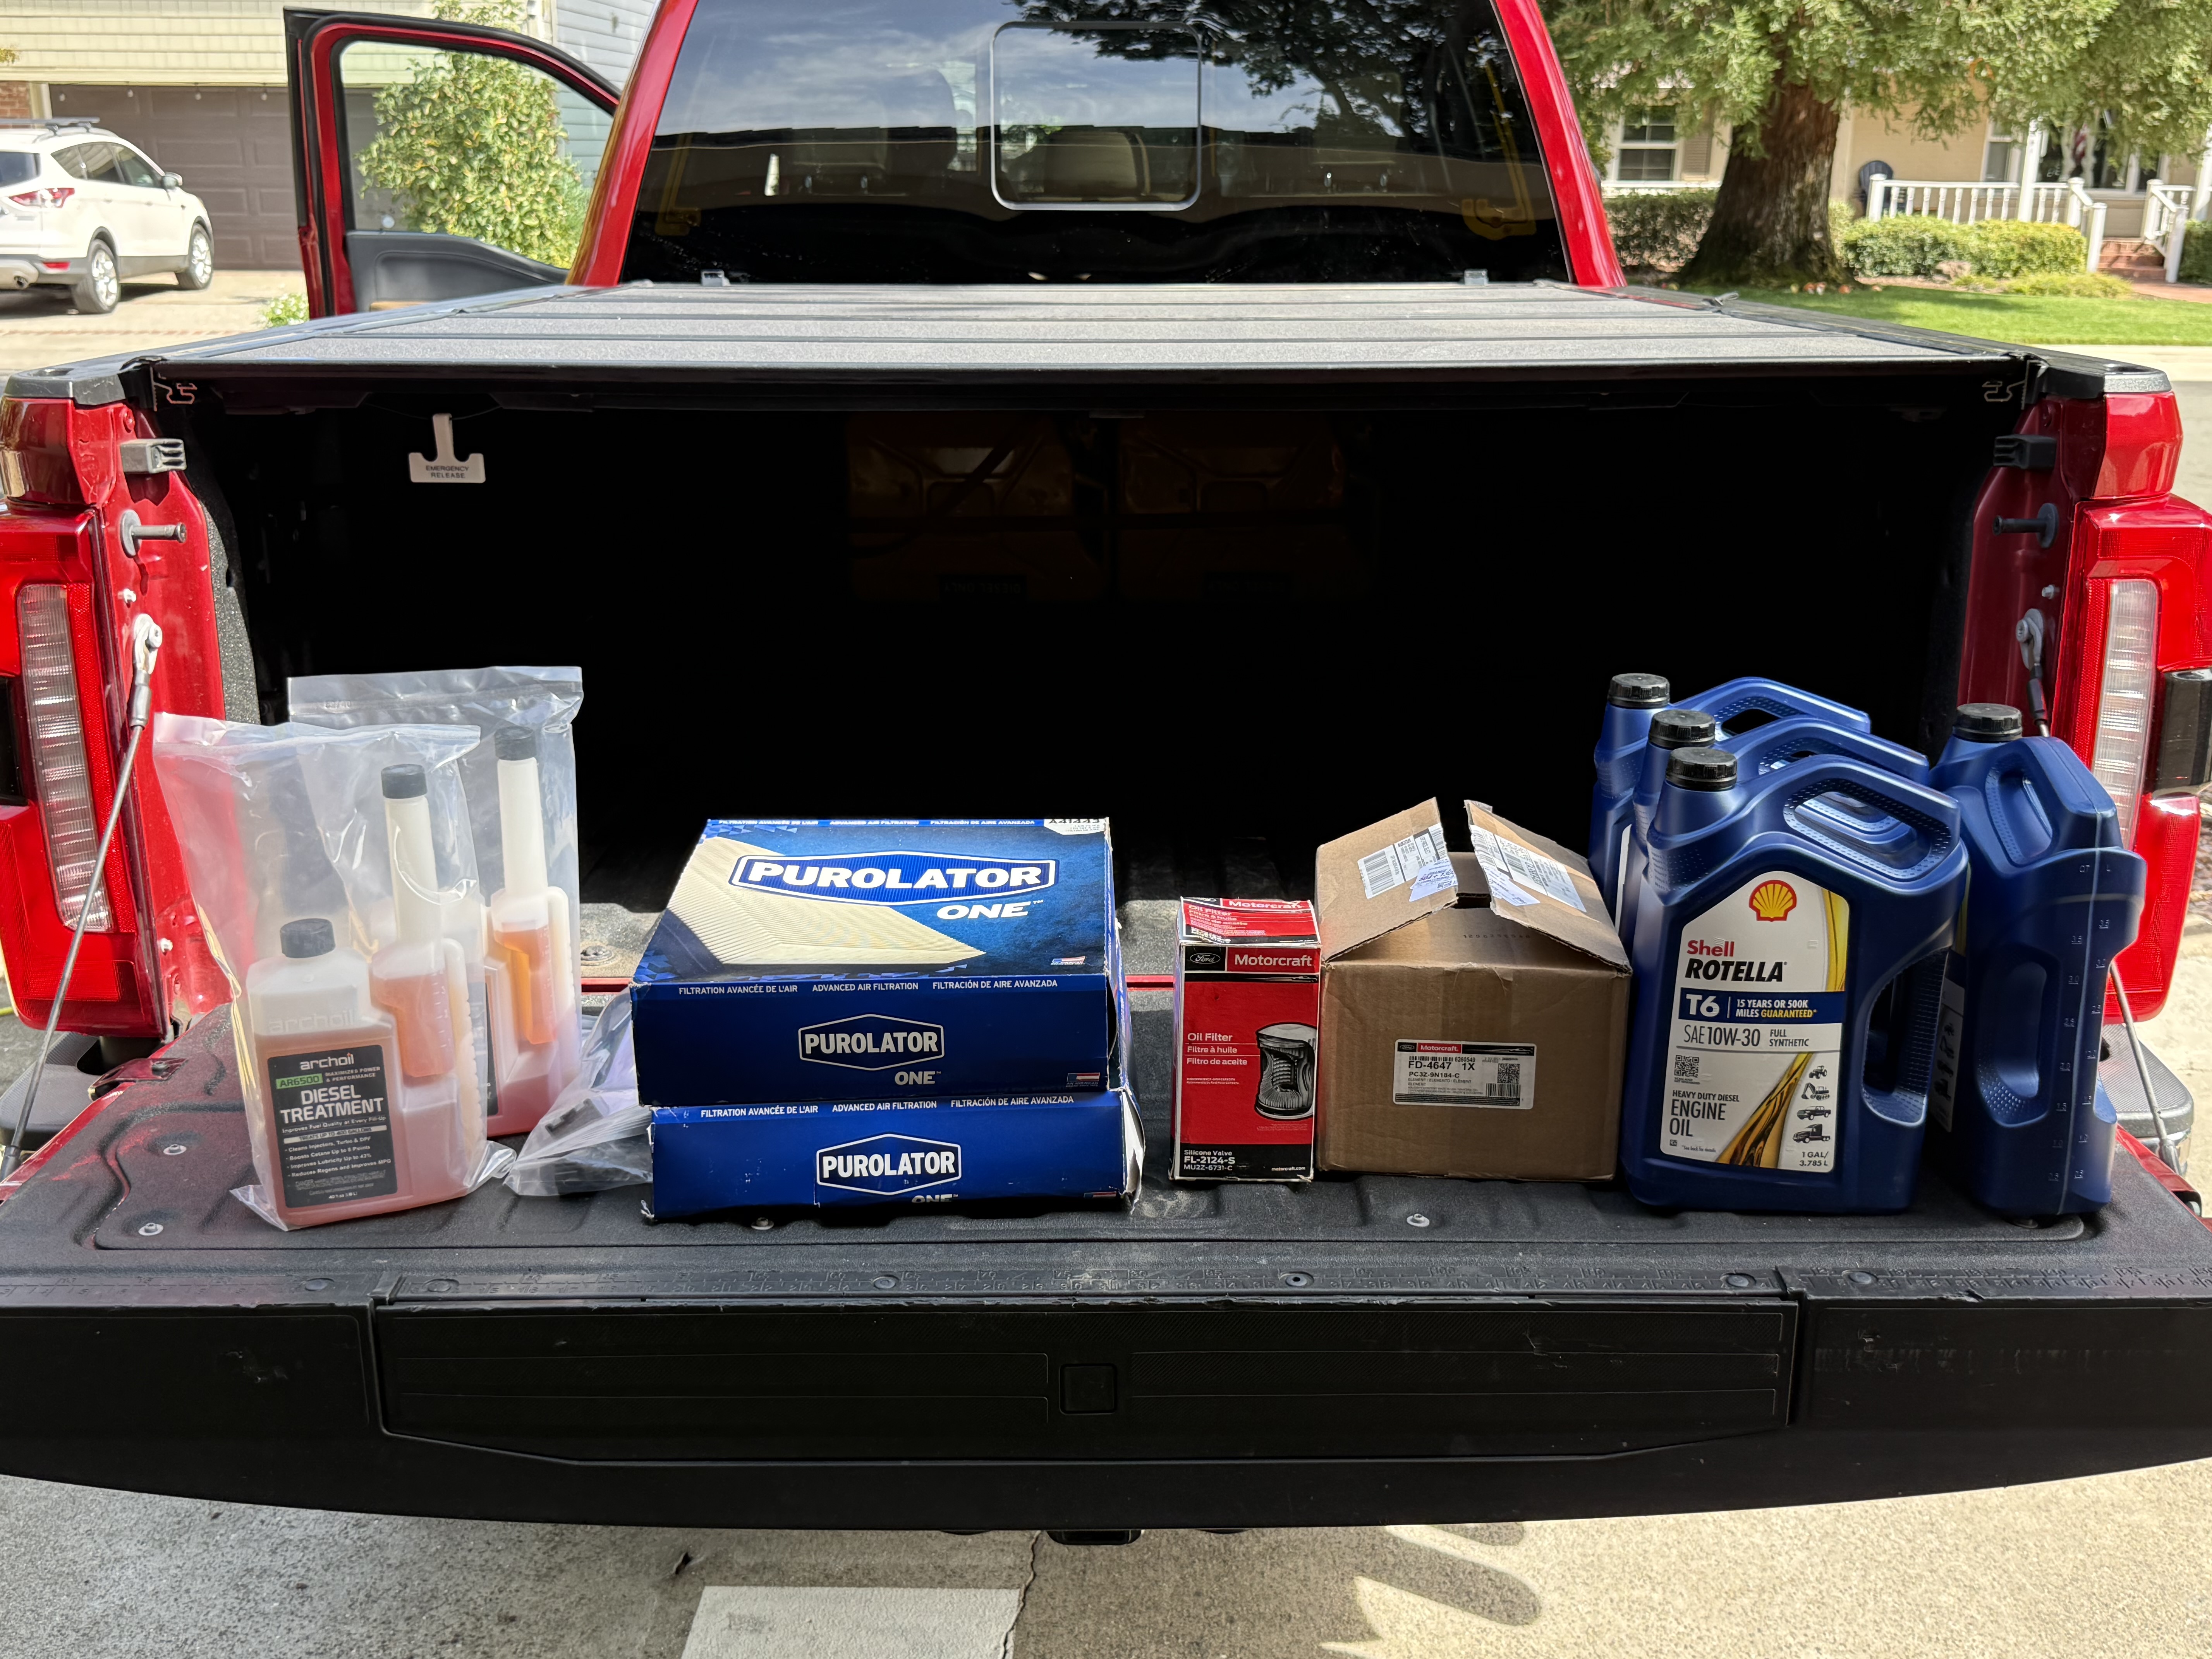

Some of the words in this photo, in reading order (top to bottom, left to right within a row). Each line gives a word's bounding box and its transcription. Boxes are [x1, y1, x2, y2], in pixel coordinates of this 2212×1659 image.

[748, 861, 1042, 888] PUROLATOR
[937, 902, 1031, 920] ONE
[1687, 939, 1734, 957] Shell
[1195, 954, 1215, 962] Ford
[1235, 954, 1312, 966] Motorcraft
[1685, 958, 1783, 982] ROTELLA
[679, 986, 725, 994] FILTRATION
[727, 984, 764, 993] AVANCÉE
[873, 982, 918, 991] FILTRATION
[933, 980, 979, 989] FILTRACIÓN
[993, 980, 1011, 988] AIRE
[1014, 979, 1058, 988] AVANZADA
[1686, 994, 1720, 1017] T6
[1737, 1000, 1745, 1008] 15
[1747, 1000, 1772, 1008] YEARS
[1788, 1000, 1808, 1008] 500K
[1736, 1009, 1759, 1017] MILES
[805, 1032, 938, 1054] PUROLATOR
[1188, 1033, 1202, 1041] Oil
[1205, 1033, 1233, 1041] Filter
[1684, 1025, 1705, 1044] SAE
[1707, 1026, 1760, 1046] 10W-30
[1769, 1038, 1809, 1046] SYNTHETIC
[300, 1053, 354, 1070] archoil
[1408, 1061, 1451, 1070] FD-4647
[280, 1075, 319, 1087] AR6500
[332, 1073, 376, 1082] PERFORMANCE
[895, 1071, 935, 1085] ONE
[301, 1085, 361, 1105] DIESEL
[1673, 1090, 1696, 1098] HEAVY
[280, 1097, 383, 1123] TREATMENT
[701, 1108, 746, 1118] FILTRATION
[748, 1105, 785, 1116] AVANCÉE
[799, 1105, 818, 1113] L'AIR
[832, 1103, 875, 1112] ADVANCED
[877, 1102, 890, 1111] AIR
[893, 1101, 937, 1110] FILTRATION
[951, 1097, 996, 1108] FILTRACIÓN
[1010, 1097, 1029, 1105] AIRE
[1030, 1096, 1074, 1104] AVANZADA
[1671, 1099, 1726, 1120] ENGINE
[1669, 1118, 1693, 1137] OIL
[823, 1151, 955, 1178] PUROLATOR
[1184, 1156, 1235, 1164] FL-2124-S
